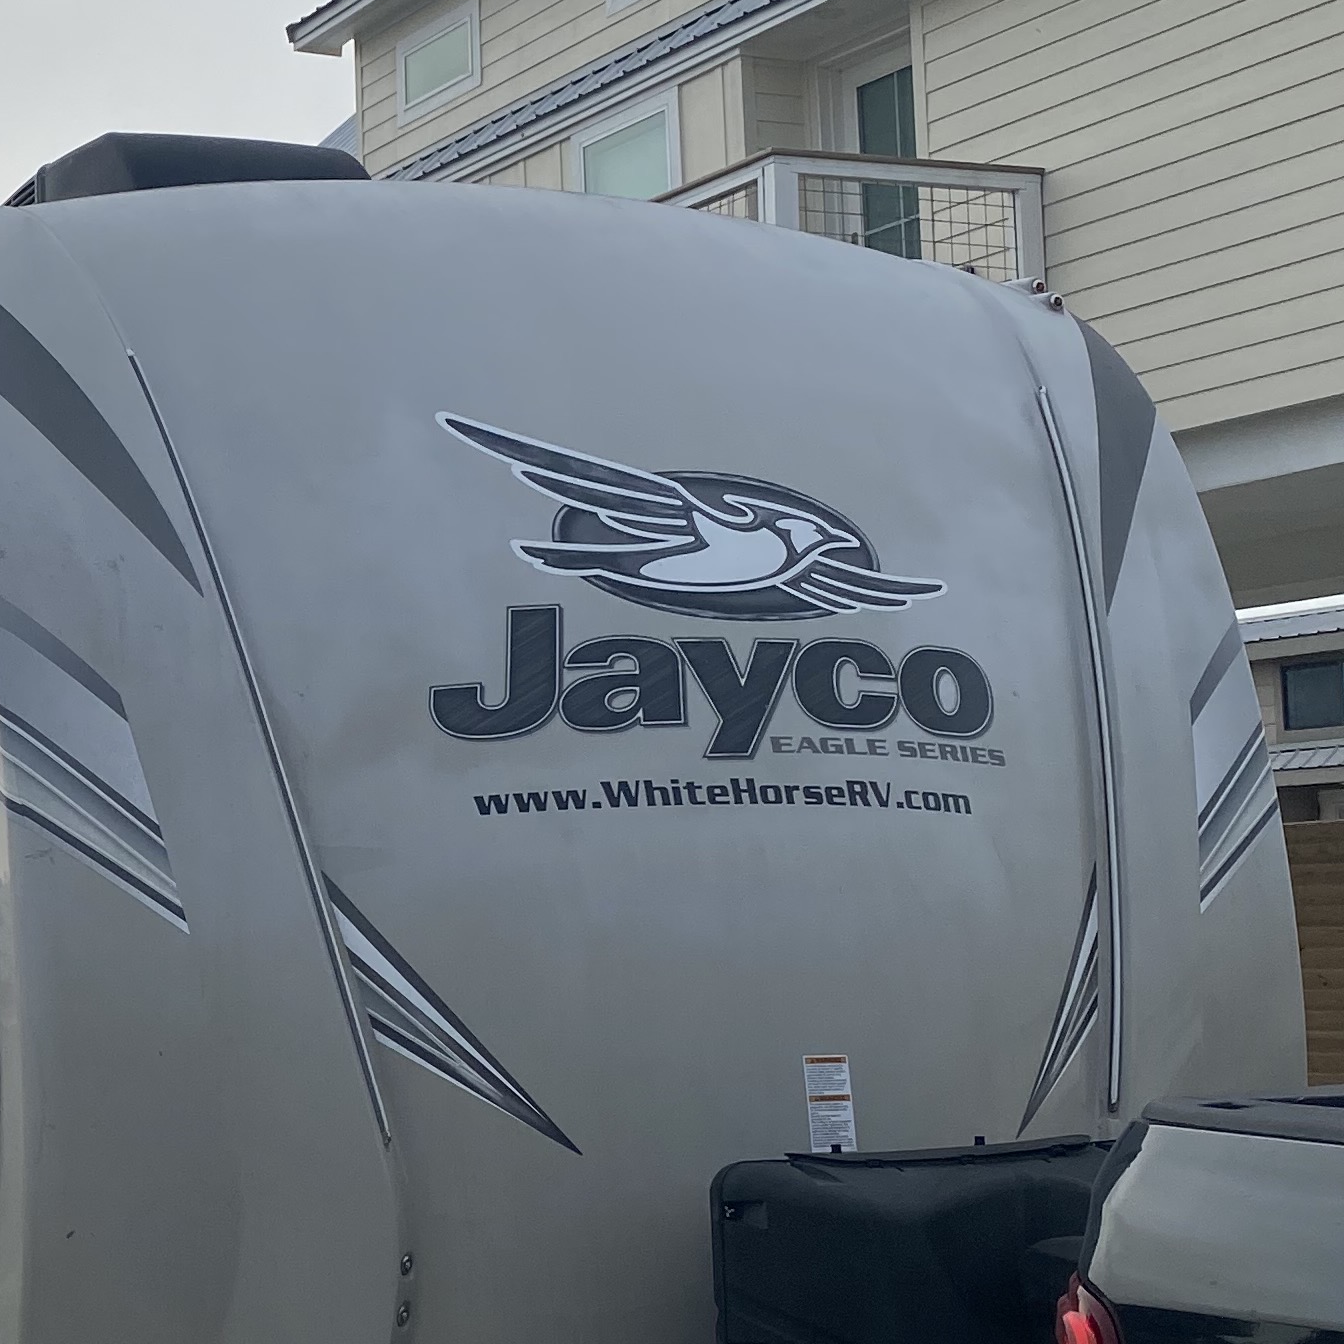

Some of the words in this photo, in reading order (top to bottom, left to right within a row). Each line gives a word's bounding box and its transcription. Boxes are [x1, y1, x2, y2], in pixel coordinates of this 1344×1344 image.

[429, 604, 994, 760] Jayco
[770, 736, 889, 756] EAGLE
[897, 740, 1006, 767] SERIES
[473, 777, 972, 815] www.WhiteHorseRV.com
